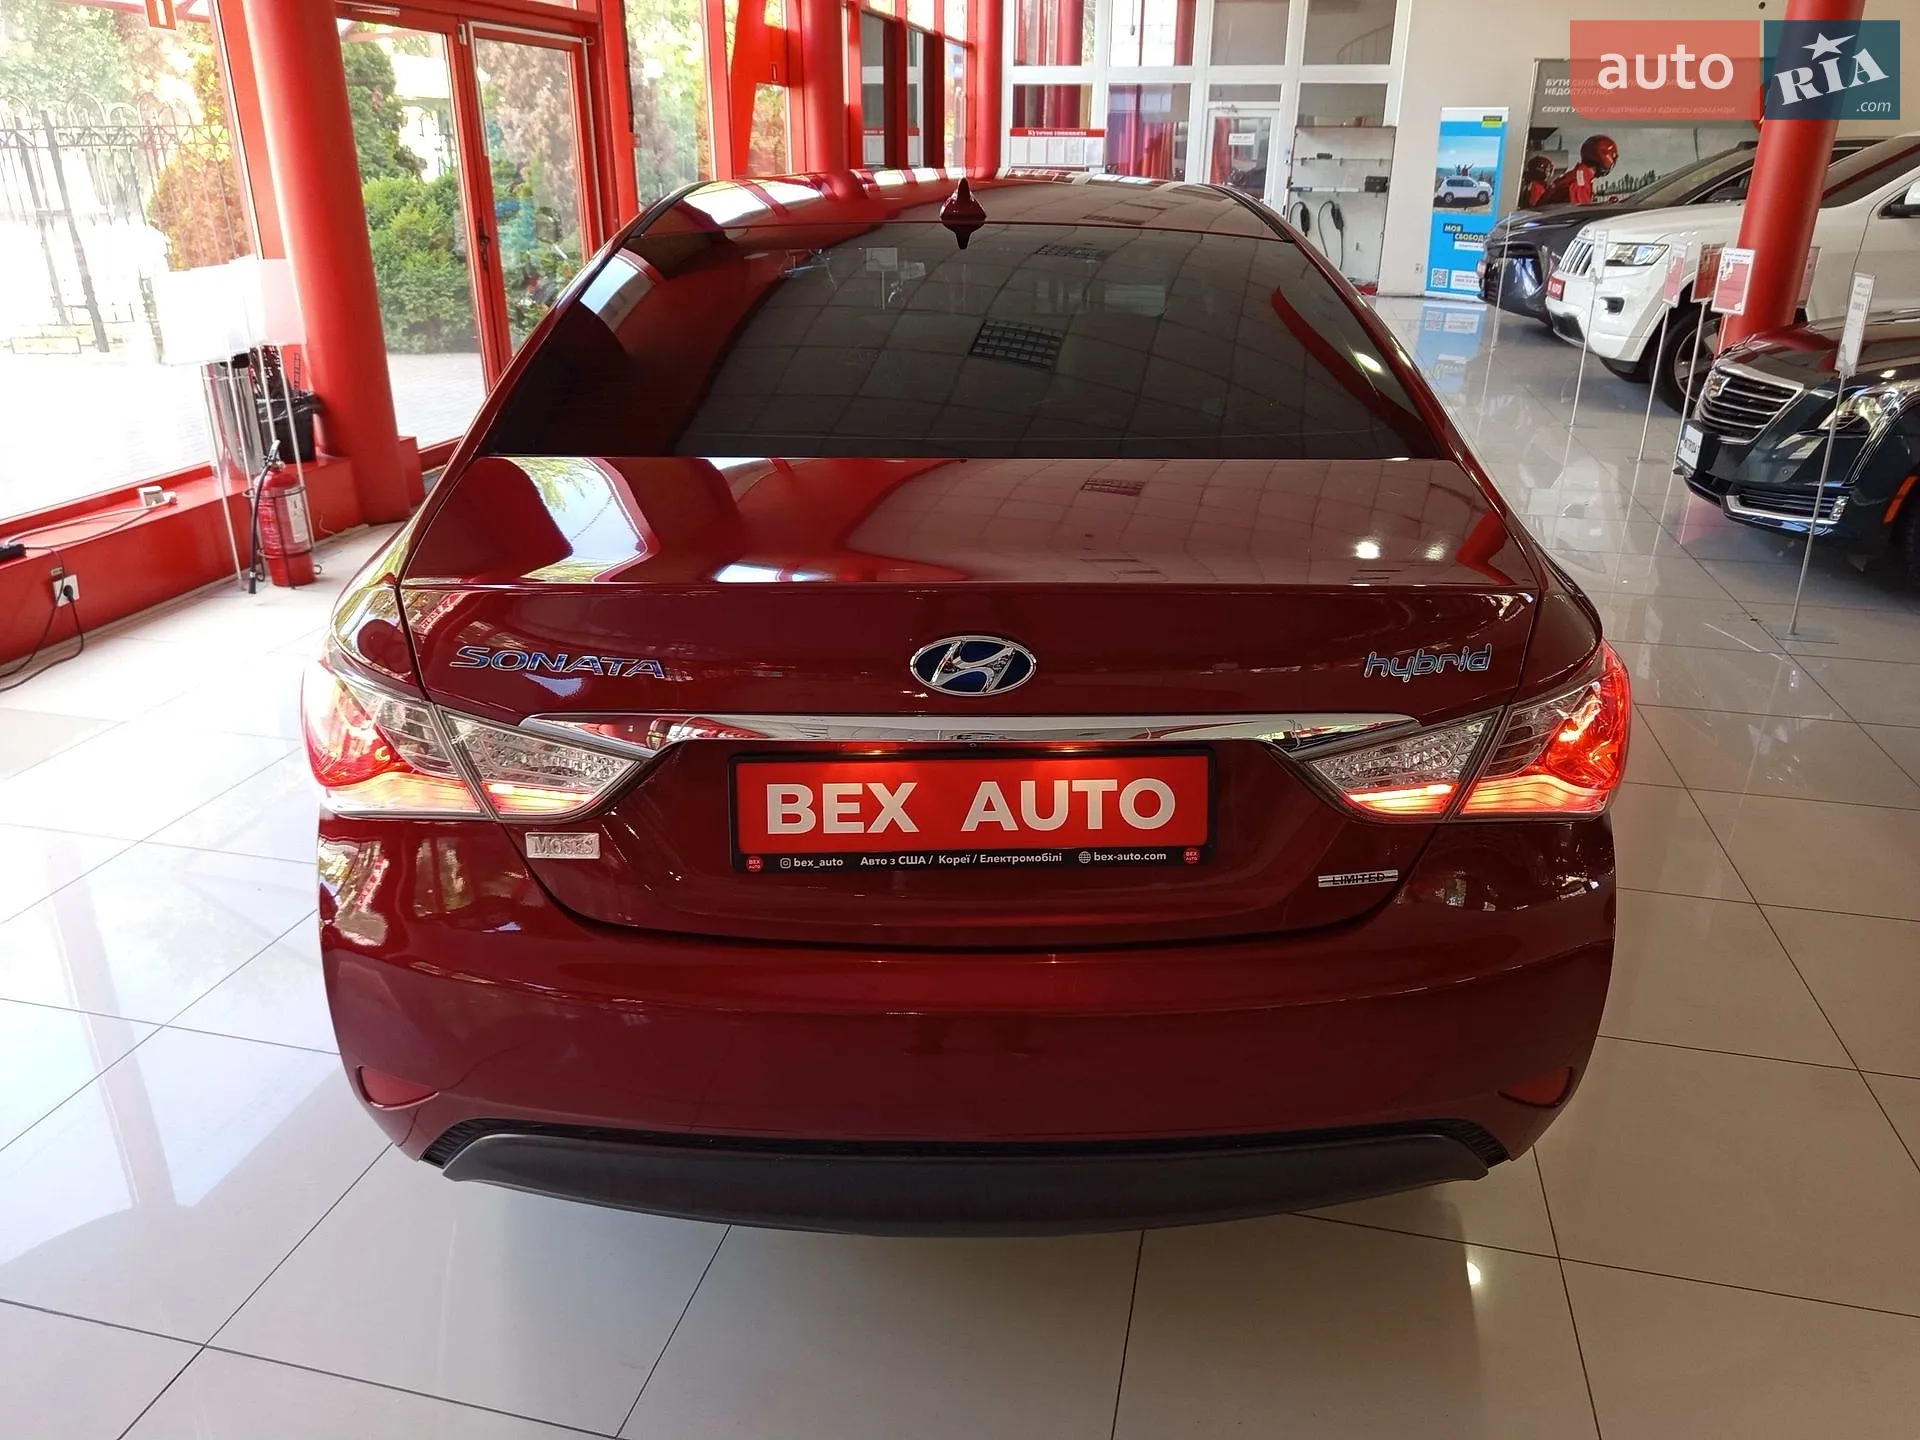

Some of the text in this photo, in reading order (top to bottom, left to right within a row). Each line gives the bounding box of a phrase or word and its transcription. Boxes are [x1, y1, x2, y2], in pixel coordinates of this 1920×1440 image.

[1444, 224, 1461, 233] МОЯ
[450, 645, 666, 678] SONATA
[1363, 643, 1492, 682] hybrid
[766, 778, 1176, 834] BEX AUTO
[860, 856, 887, 866] Авто
[898, 856, 926, 865] США
[938, 854, 970, 867] Кореї
[979, 852, 1062, 865] Електромобілі
[1093, 851, 1167, 861] bex-auto.com
[793, 857, 844, 870] bex_auto
[1332, 872, 1385, 886] LIMITED
